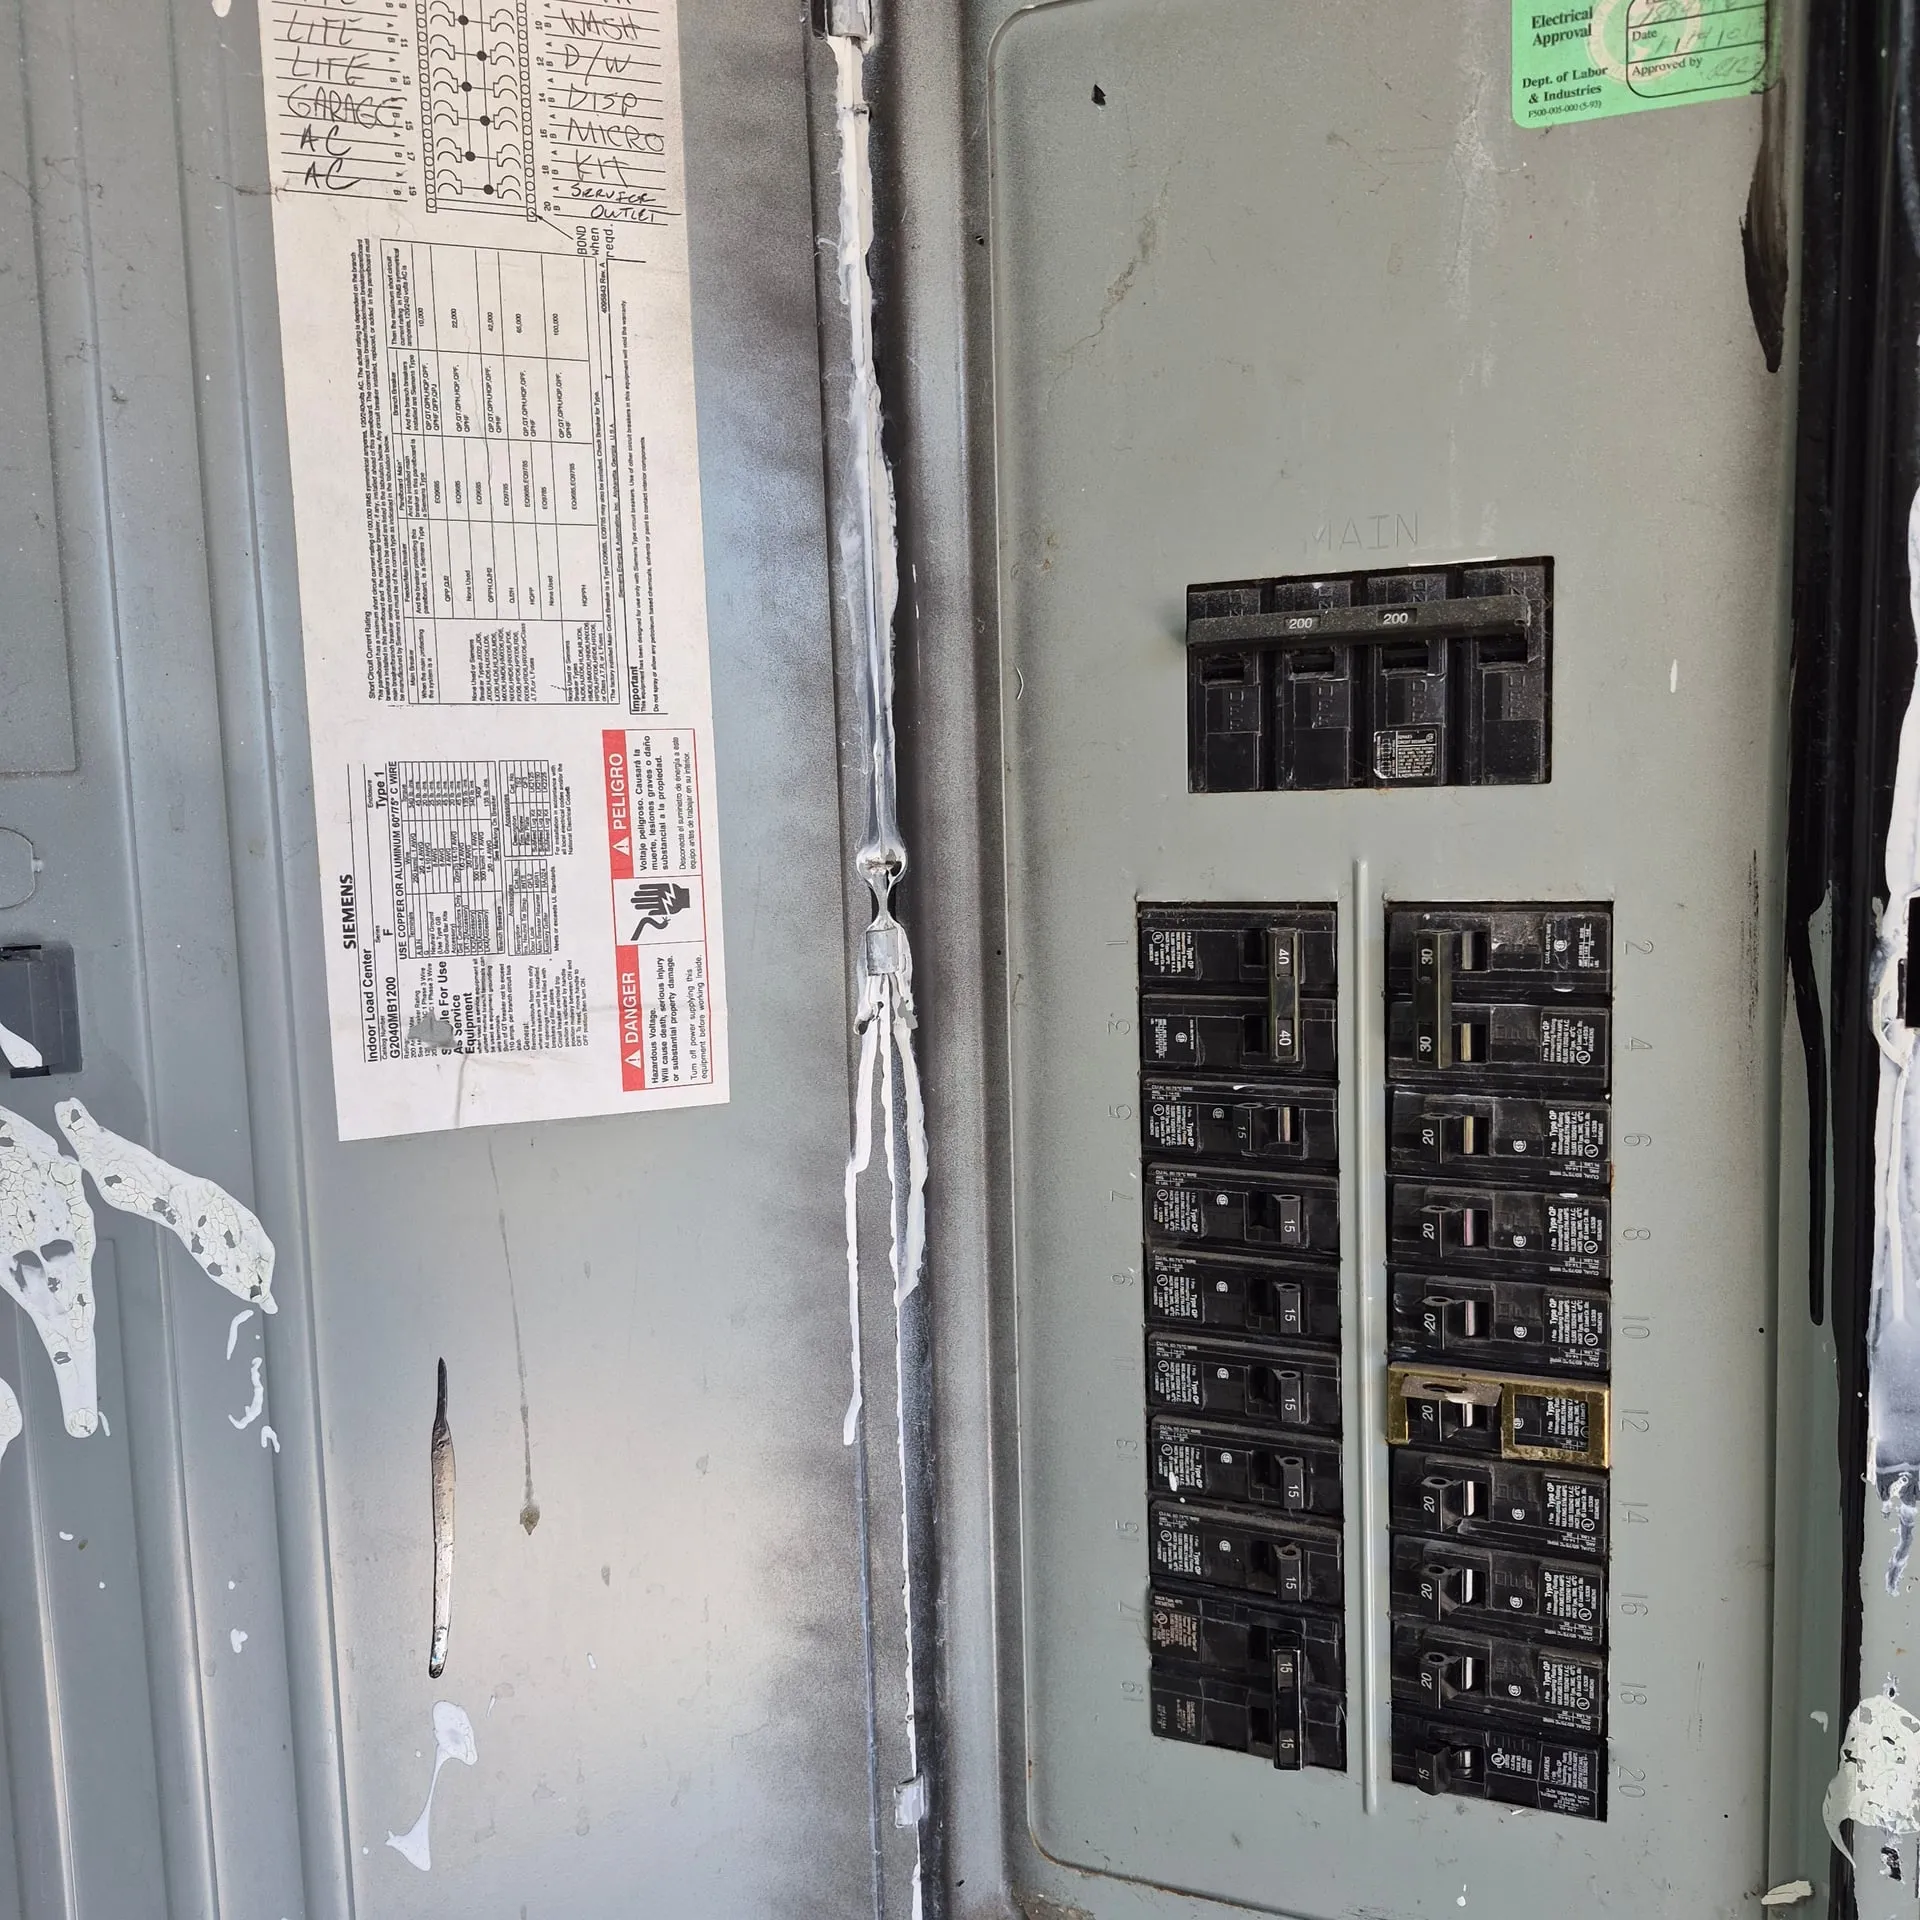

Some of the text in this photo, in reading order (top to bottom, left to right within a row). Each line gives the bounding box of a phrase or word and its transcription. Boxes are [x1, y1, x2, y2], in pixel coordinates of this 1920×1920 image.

[1531, 6, 1594, 29] Electrical
[1532, 24, 1592, 47] Approval
[1631, 28, 1657, 42] Date
[1522, 65, 1608, 89] Dept. of Labor
[1632, 58, 1685, 76] Approved
[1688, 56, 1703, 70] by
[568, 83, 637, 117] DISP
[1528, 84, 1602, 104] & Industries
[300, 123, 351, 156] AC
[567, 117, 664, 152] MICRO
[304, 158, 361, 190] AC
[576, 226, 587, 254] BOND
[590, 228, 599, 255] when
[604, 224, 615, 257] reqd.
[1303, 513, 1420, 552] MAIN
[1289, 612, 1409, 629] 200 200
[630, 666, 640, 712] Important
[643, 736, 651, 757] daño
[389, 761, 397, 784] WIRE
[633, 760, 643, 794] Causará
[655, 755, 665, 799] propiedad.
[376, 781, 387, 809] Type
[609, 753, 626, 830] PELIGRO
[675, 783, 682, 791] de
[686, 785, 692, 793] en
[685, 795, 694, 819] trabajar
[637, 798, 647, 839] peligroso.
[648, 801, 656, 836] lesiones
[687, 820, 694, 828] de
[393, 831, 402, 880] ALUMINUM
[639, 843, 647, 871] Voltaje
[659, 823, 668, 870] substancial
[689, 849, 697, 869] equipo
[395, 883, 404, 896] OR
[340, 874, 357, 949] SIEMENS
[396, 899, 406, 938] COPPER
[399, 941, 407, 960] USE
[1421, 948, 1434, 965] 30
[1624, 940, 1653, 955] 2
[438, 961, 447, 979] Use
[656, 957, 665, 980] injury
[667, 956, 675, 988] damage.
[363, 948, 378, 1062] Indoor Load Center
[439, 982, 449, 1006] For
[687, 986, 696, 1020] supplying
[697, 983, 705, 1010] working
[386, 977, 400, 1058] G2040MB1200
[453, 994, 462, 1036] Service
[622, 972, 639, 1043] DANGER
[669, 992, 678, 1024] property
[463, 992, 476, 1054] Equipment
[659, 1015, 667, 1038] death,
[1106, 1019, 1131, 1036] 3
[649, 1008, 658, 1083] Hazardous Voltage.
[689, 1024, 697, 1046] power
[1278, 1030, 1291, 1045] 40
[1419, 1036, 1432, 1053] 30
[1623, 1036, 1652, 1052] 4
[660, 1041, 668, 1064] cause
[670, 1027, 679, 1070] substantial
[700, 1041, 708, 1079] equipment
[661, 1068, 669, 1083] Will
[1108, 1104, 1131, 1120] 5
[1237, 1126, 1246, 1138] 15
[1422, 1128, 1434, 1146] 20
[1623, 1133, 1652, 1147] 6
[1110, 1190, 1133, 1202] 7
[1284, 1219, 1295, 1232] 15
[1422, 1223, 1435, 1240] 20
[1621, 1227, 1651, 1242] 8
[1111, 1274, 1133, 1286] 9
[1285, 1309, 1296, 1321] 15
[1422, 1312, 1435, 1330] 20
[1621, 1315, 1649, 1338] 10
[1285, 1398, 1296, 1410] 15
[1422, 1403, 1434, 1422] 20
[1620, 1409, 1649, 1433] 12
[1288, 1484, 1299, 1498] 15
[1422, 1495, 1435, 1513] 20
[1620, 1502, 1648, 1524] 14
[1285, 1577, 1297, 1589] 15
[1420, 1582, 1433, 1600] 20
[1619, 1594, 1648, 1616] 16
[1280, 1661, 1292, 1673] 15
[1120, 1681, 1144, 1702] 19
[1421, 1672, 1434, 1690] 20
[1618, 1683, 1647, 1704] 18
[1281, 1737, 1294, 1749] 15
[1617, 1766, 1646, 1798] 20
